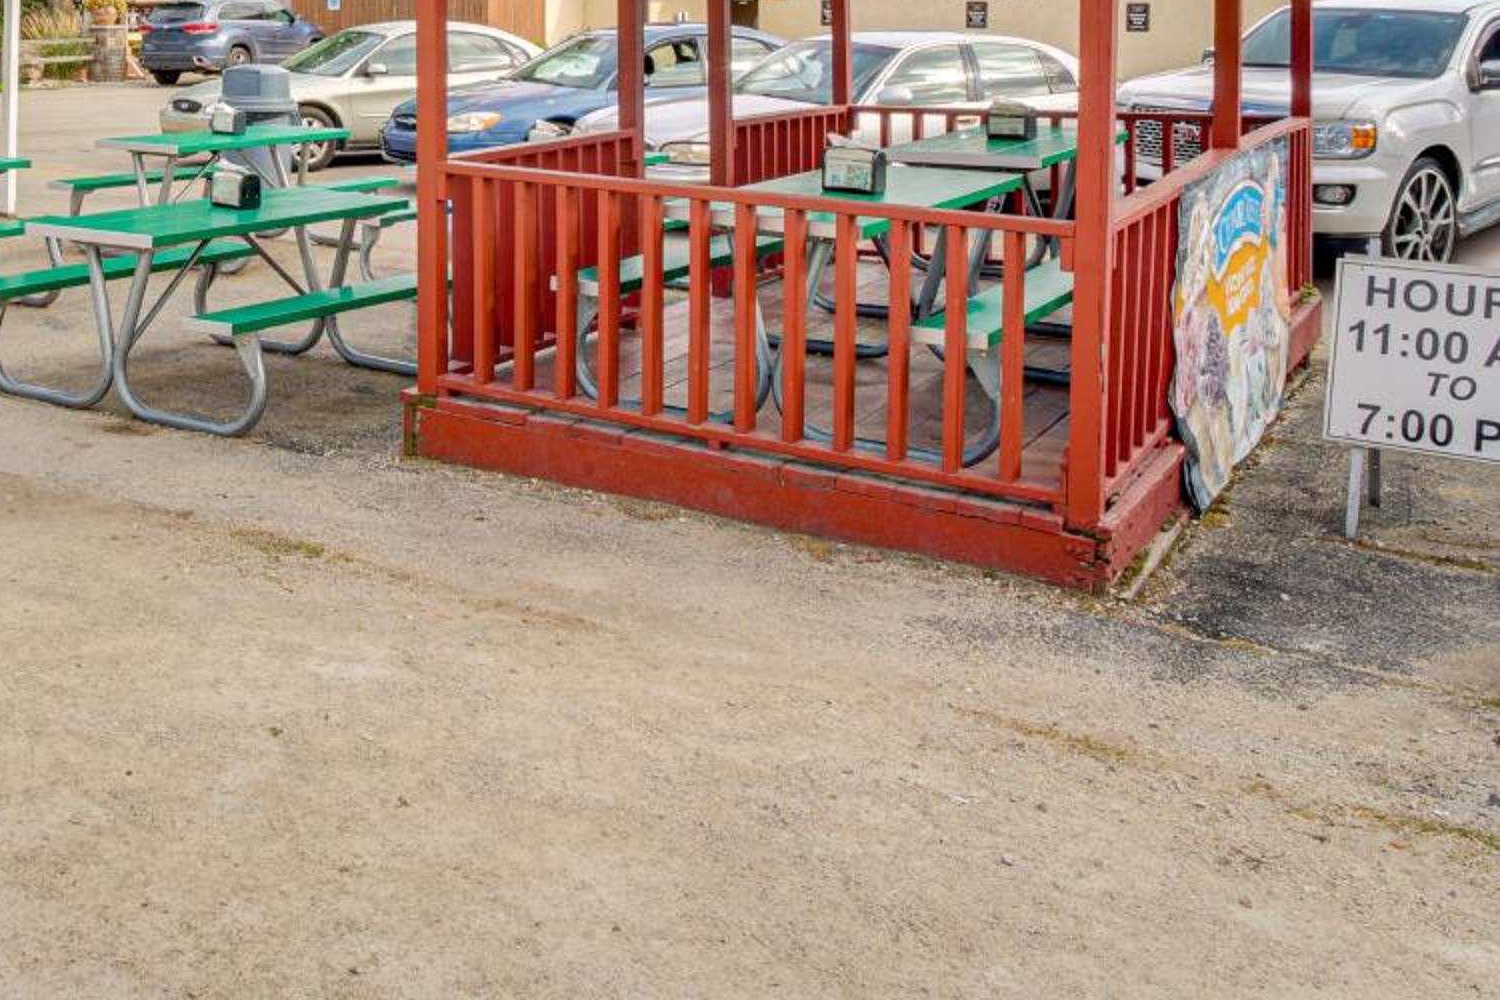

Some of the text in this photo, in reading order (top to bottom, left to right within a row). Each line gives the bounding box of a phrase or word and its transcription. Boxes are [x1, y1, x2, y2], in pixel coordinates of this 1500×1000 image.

[1348, 319, 1469, 365] 11:00
[1427, 371, 1478, 401] TO
[1357, 402, 1454, 447] 7:00
